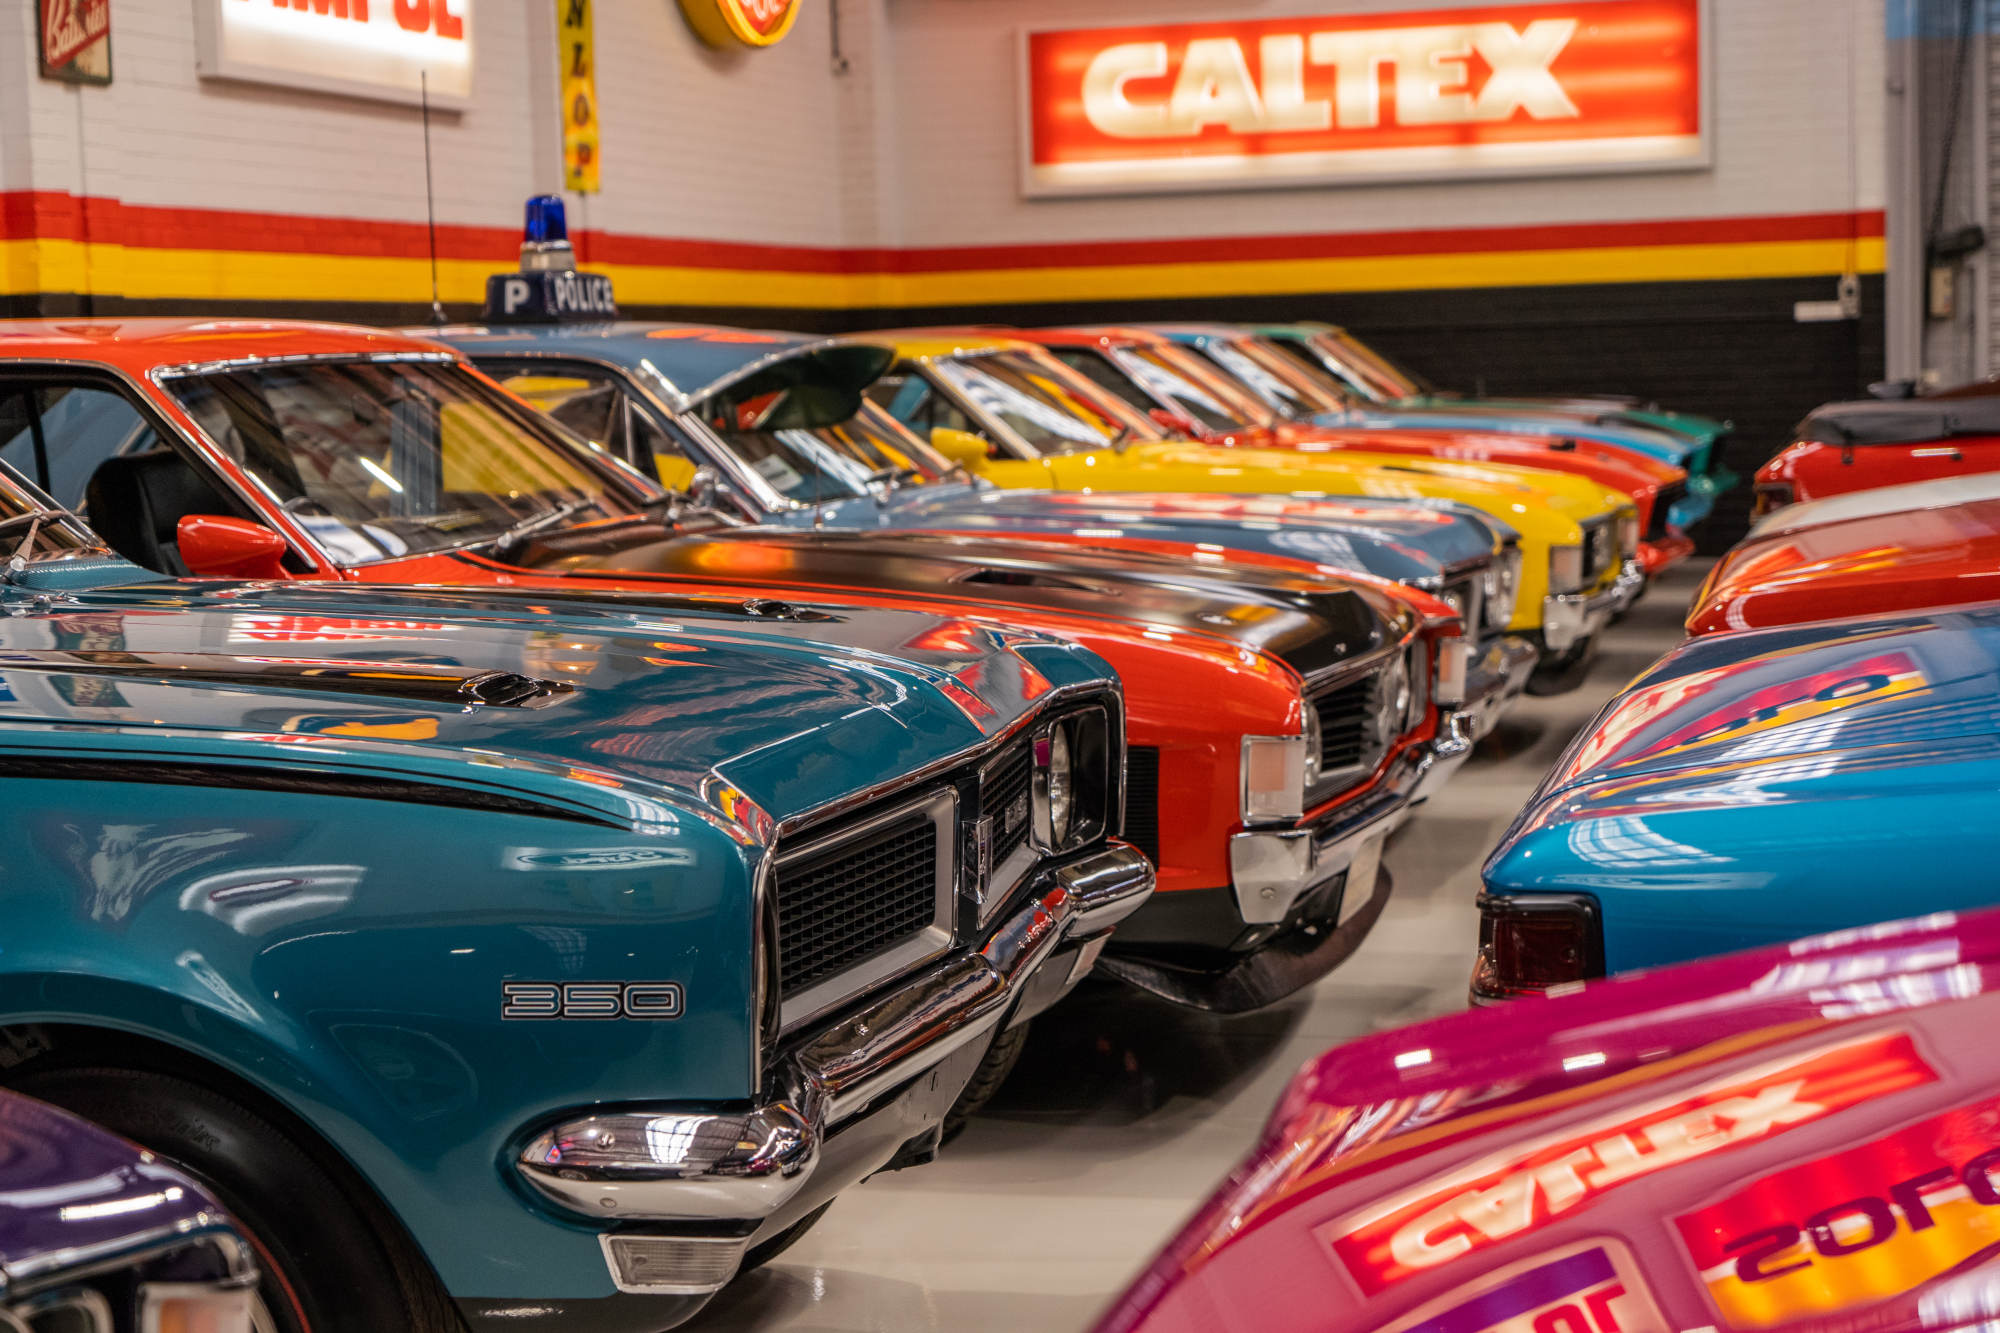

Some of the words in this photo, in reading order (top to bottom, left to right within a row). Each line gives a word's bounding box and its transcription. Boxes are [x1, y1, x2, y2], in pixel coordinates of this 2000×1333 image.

[1081, 18, 1580, 138] CALTEX
[504, 279, 530, 314] P
[554, 277, 615, 313] POLICE
[501, 980, 686, 1021] 350
